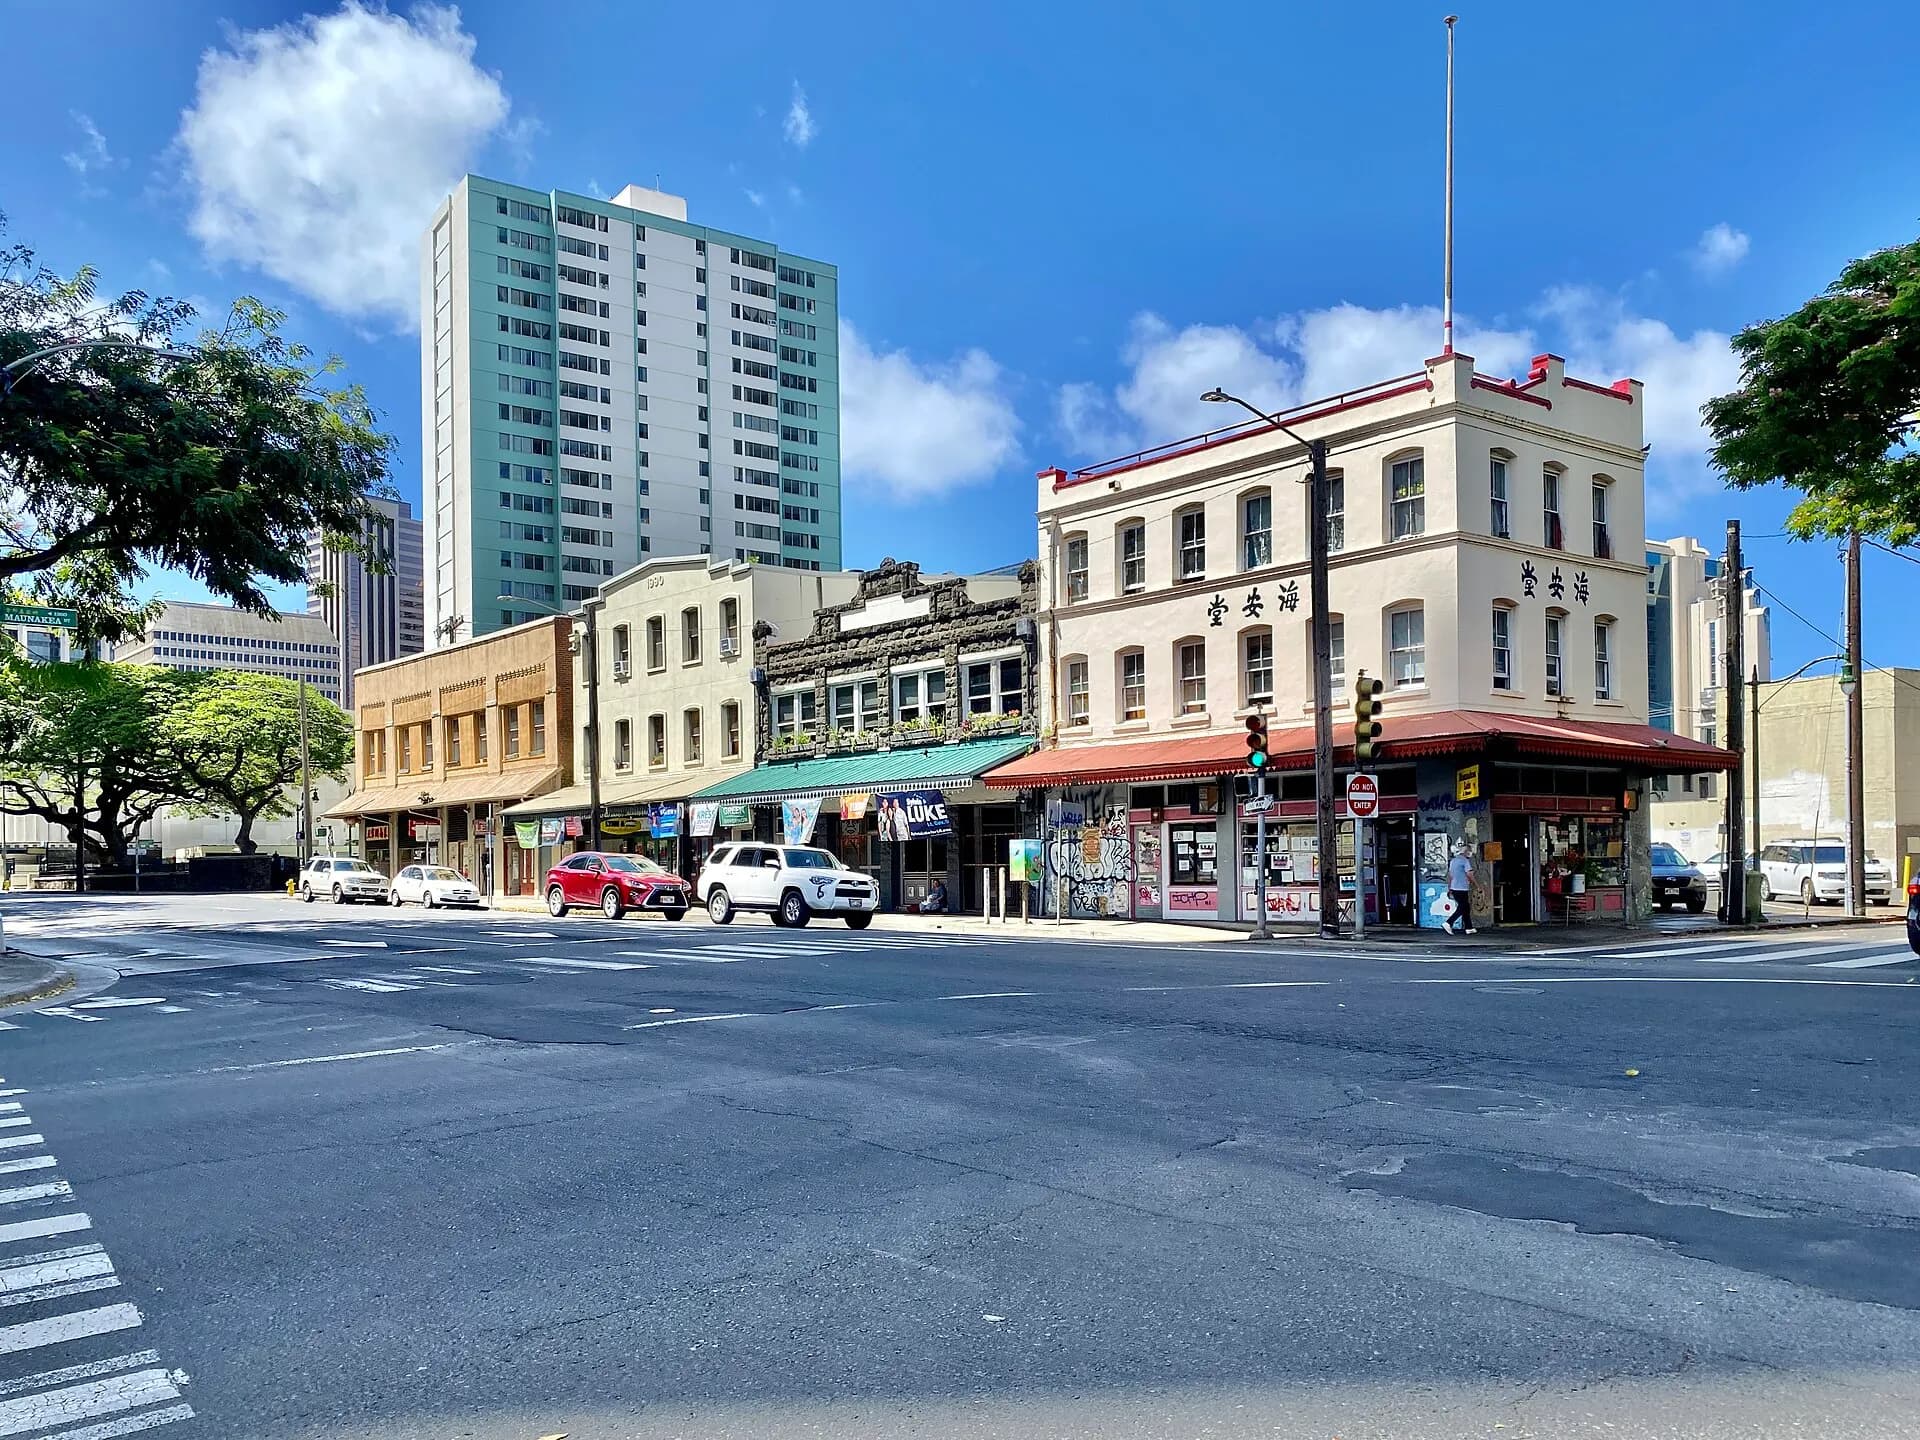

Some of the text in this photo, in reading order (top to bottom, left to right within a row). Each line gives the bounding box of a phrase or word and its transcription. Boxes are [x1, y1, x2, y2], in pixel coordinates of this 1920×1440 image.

[4, 613, 62, 625] MAUNAKEA
[1351, 783, 1374, 791] DO NOT
[1353, 801, 1372, 809] ENTER
[906, 803, 949, 823] LUKE
